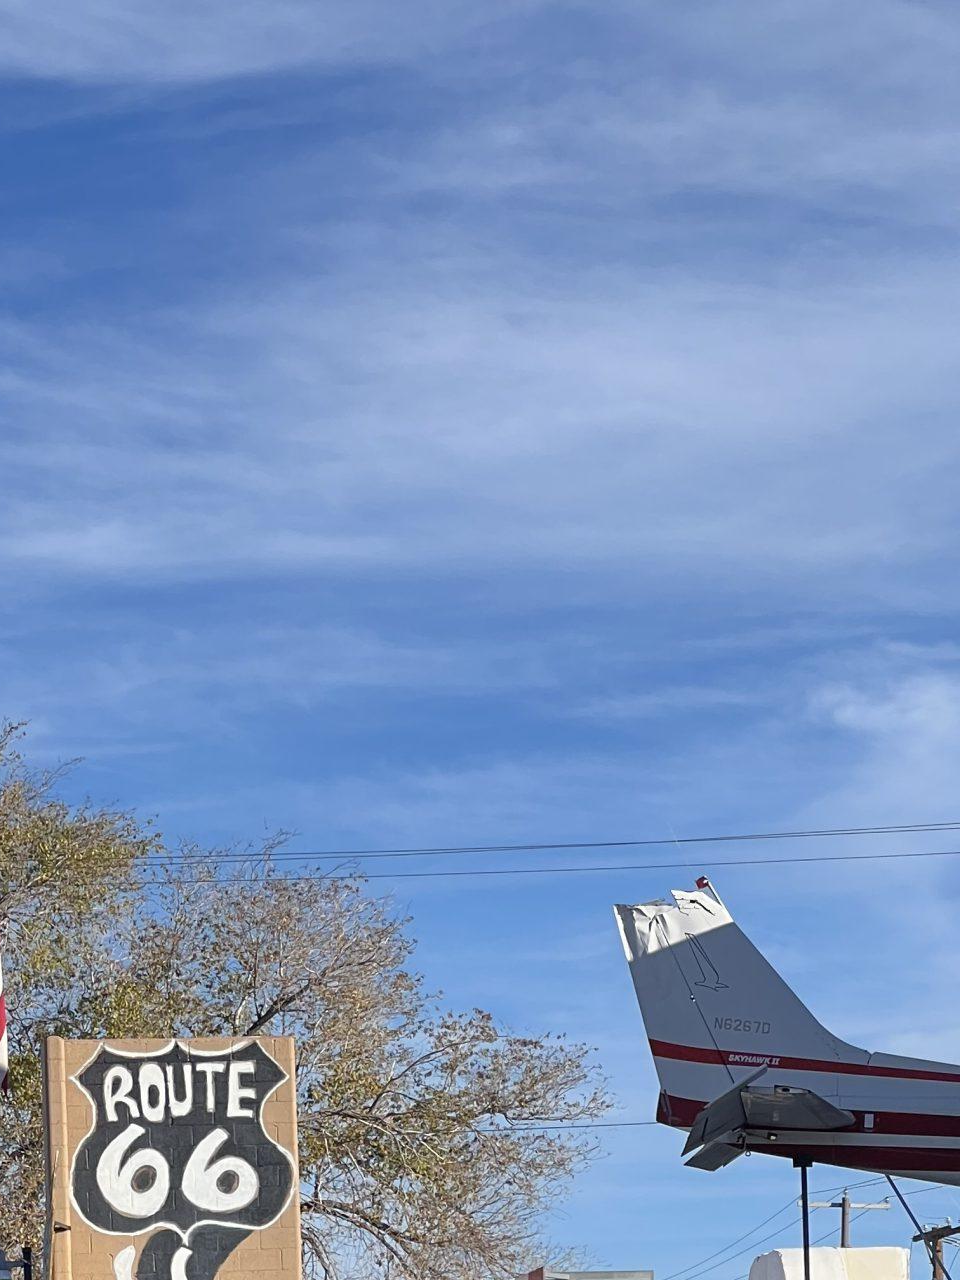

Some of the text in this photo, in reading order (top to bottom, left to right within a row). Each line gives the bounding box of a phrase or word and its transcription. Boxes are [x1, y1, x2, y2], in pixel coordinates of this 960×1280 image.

[728, 1054, 771, 1065] SKYHAWK
[103, 1060, 256, 1122] ROUTE
[96, 1123, 260, 1219] 66
